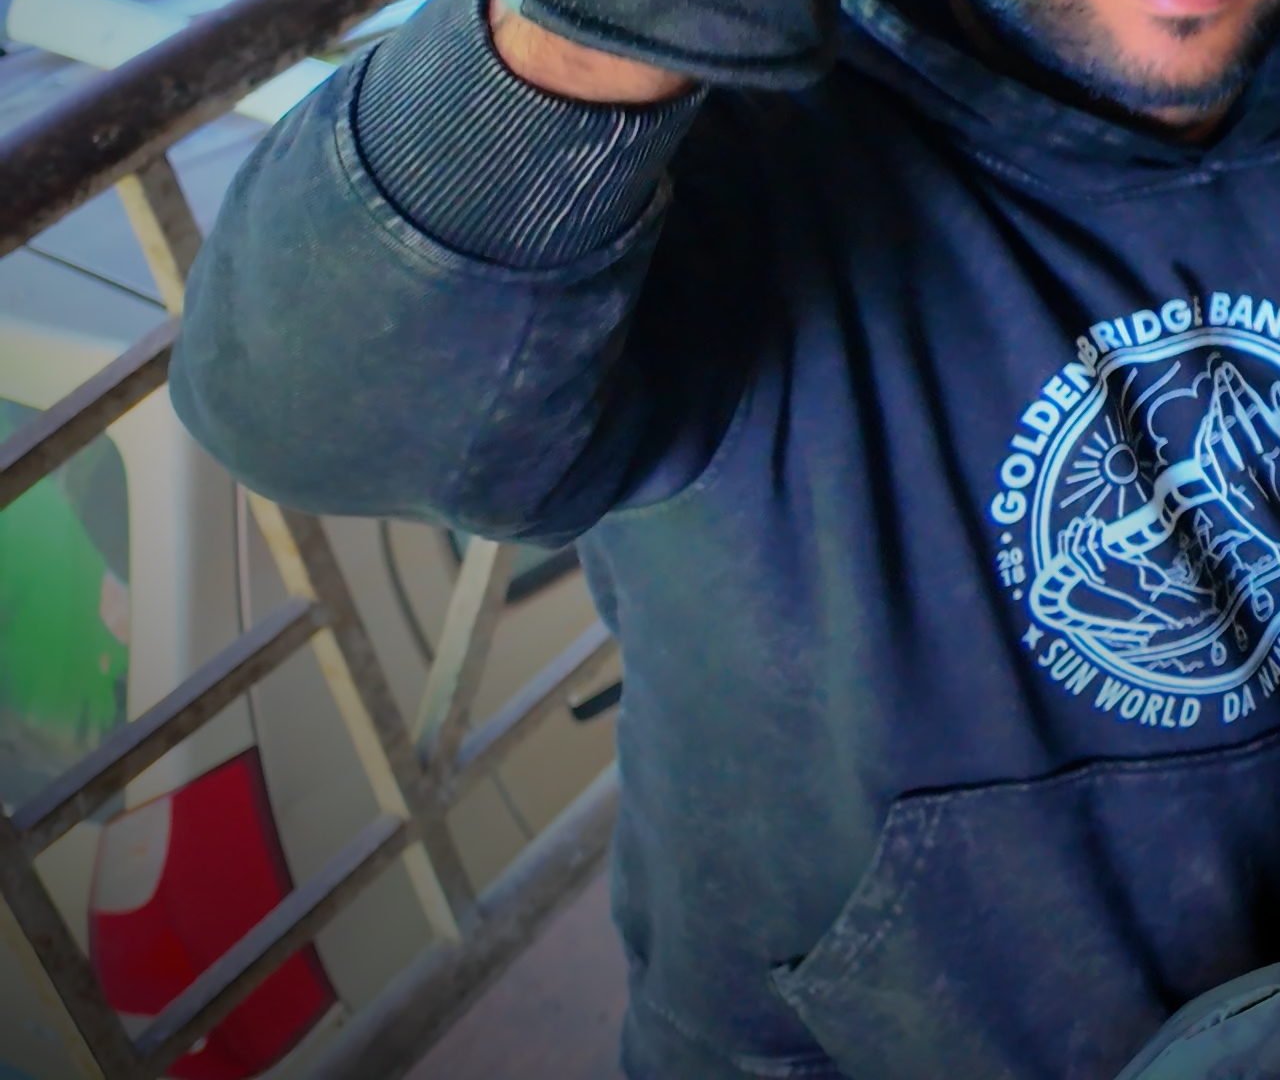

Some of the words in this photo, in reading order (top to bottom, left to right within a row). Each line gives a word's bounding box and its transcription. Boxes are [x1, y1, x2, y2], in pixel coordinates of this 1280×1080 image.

[991, 359, 1097, 524] GOLDEN
[1076, 296, 1202, 368] BRIDGE
[997, 548, 1023, 566] 20
[1038, 638, 1097, 695] SUN
[1094, 680, 1201, 728] WORLD
[1223, 683, 1257, 723] DA
